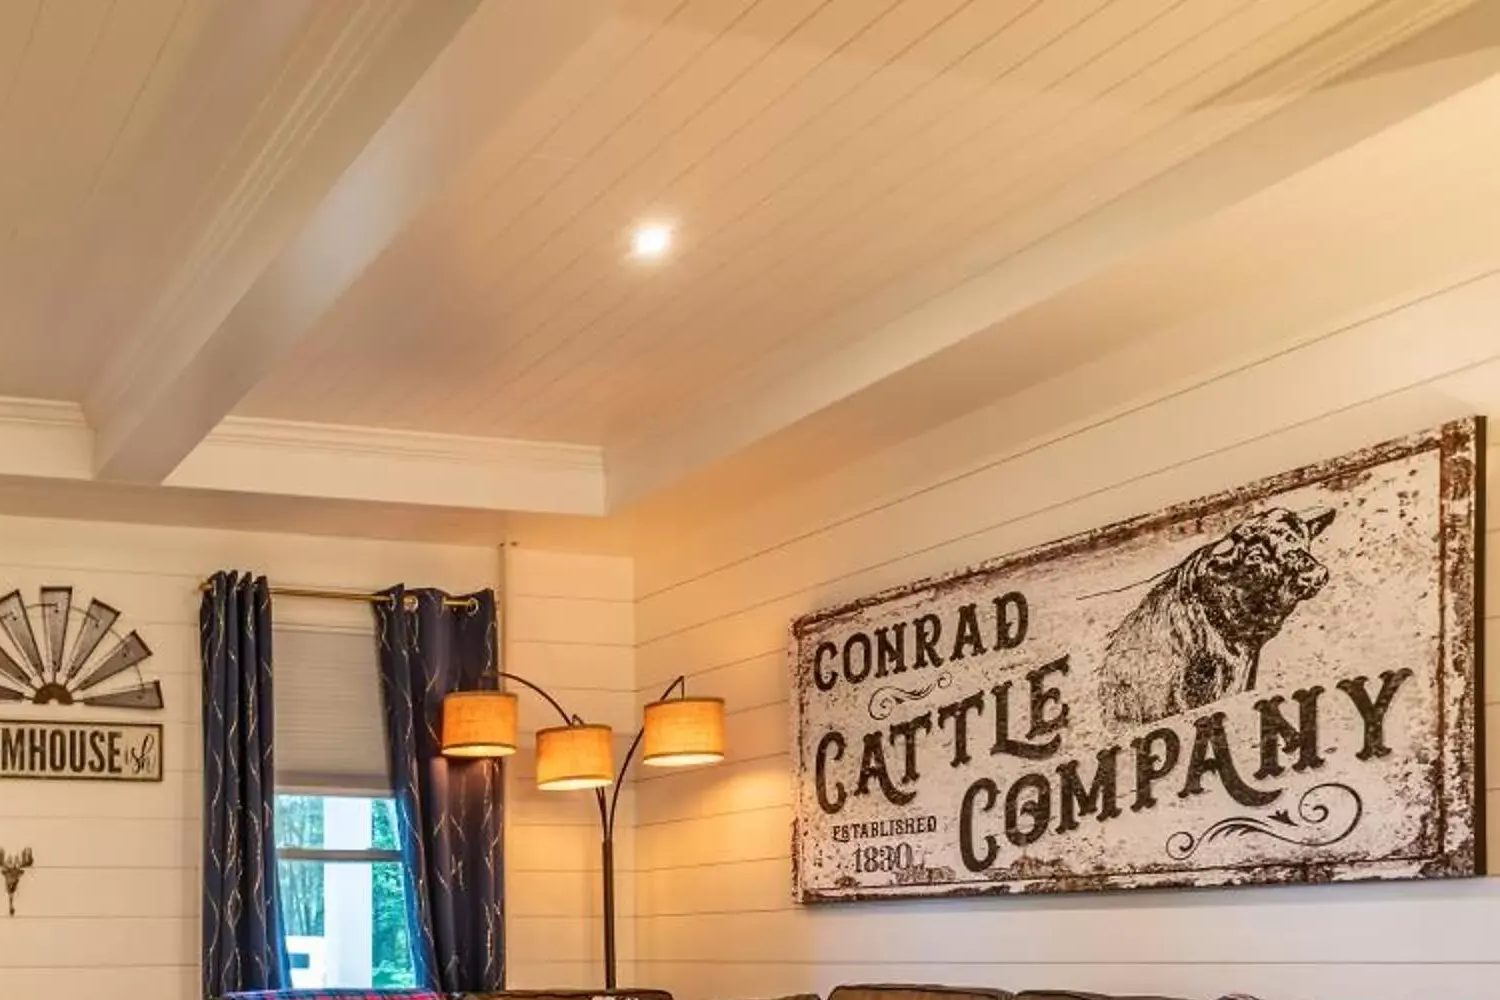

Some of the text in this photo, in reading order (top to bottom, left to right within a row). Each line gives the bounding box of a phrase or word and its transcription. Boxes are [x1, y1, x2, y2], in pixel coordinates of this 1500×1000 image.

[812, 591, 1030, 692] CONRAD
[814, 655, 1071, 814] CATTLE
[959, 668, 1413, 872] COMPANY
[832, 815, 937, 843] ESTABLISHED
